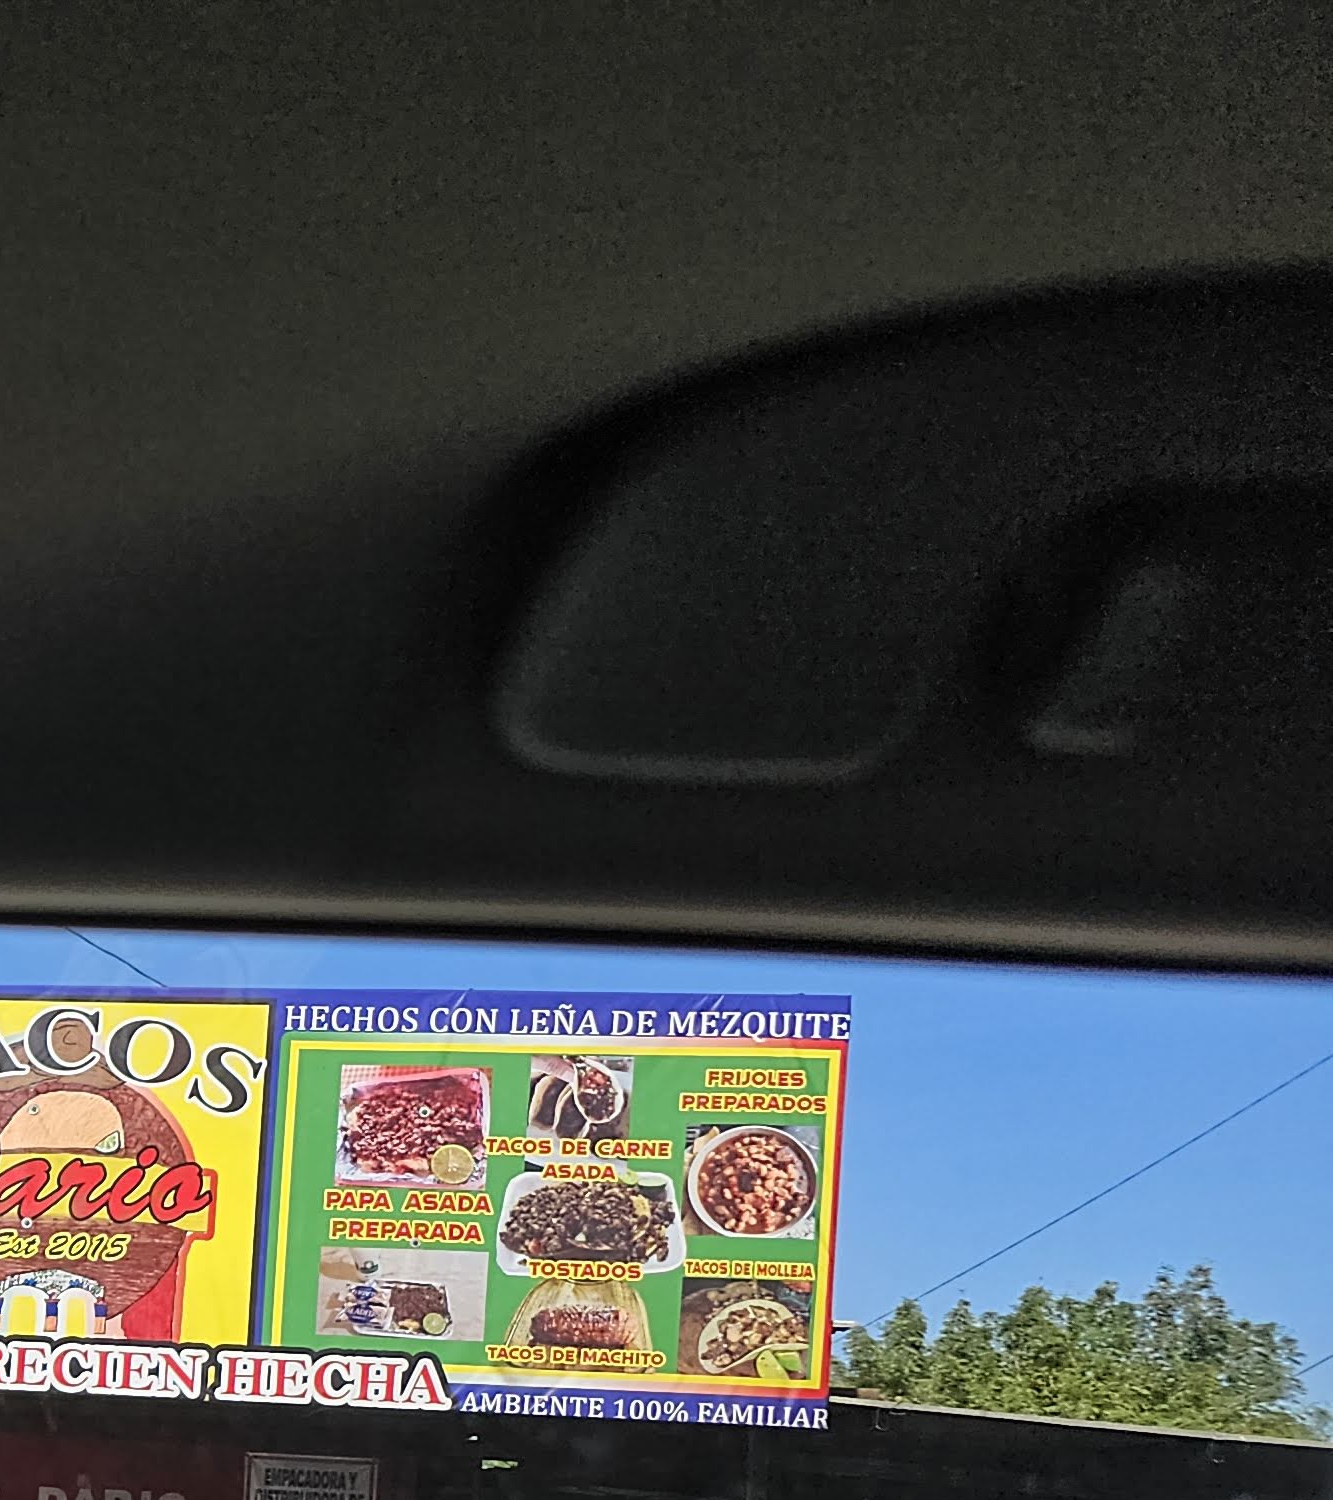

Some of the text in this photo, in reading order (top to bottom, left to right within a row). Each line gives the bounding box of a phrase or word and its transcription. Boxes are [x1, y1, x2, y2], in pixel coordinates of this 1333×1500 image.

[285, 1004, 851, 1043] HECHOS CON LEÑA DE MEZQUITE
[704, 1068, 806, 1089] FRIJOLES
[679, 1092, 827, 1114] PREPARADOS
[485, 1138, 671, 1158] TACOS DE CARNE
[541, 1163, 617, 1181] ASADA
[323, 1189, 493, 1215] PAPA ASADA
[329, 1220, 484, 1244] PREPARADA
[45, 1232, 131, 1261] 2015
[529, 1261, 643, 1281] TOSTADOS
[684, 1261, 814, 1279] TACOS DE MOLLEJA
[486, 1345, 665, 1367] TACOS DE MACHITO
[220, 1358, 450, 1411] HECHA
[460, 1392, 829, 1429] AMBIENTE 100% FAMILIAR
[265, 1468, 358, 1490] EMPACADORA Y
